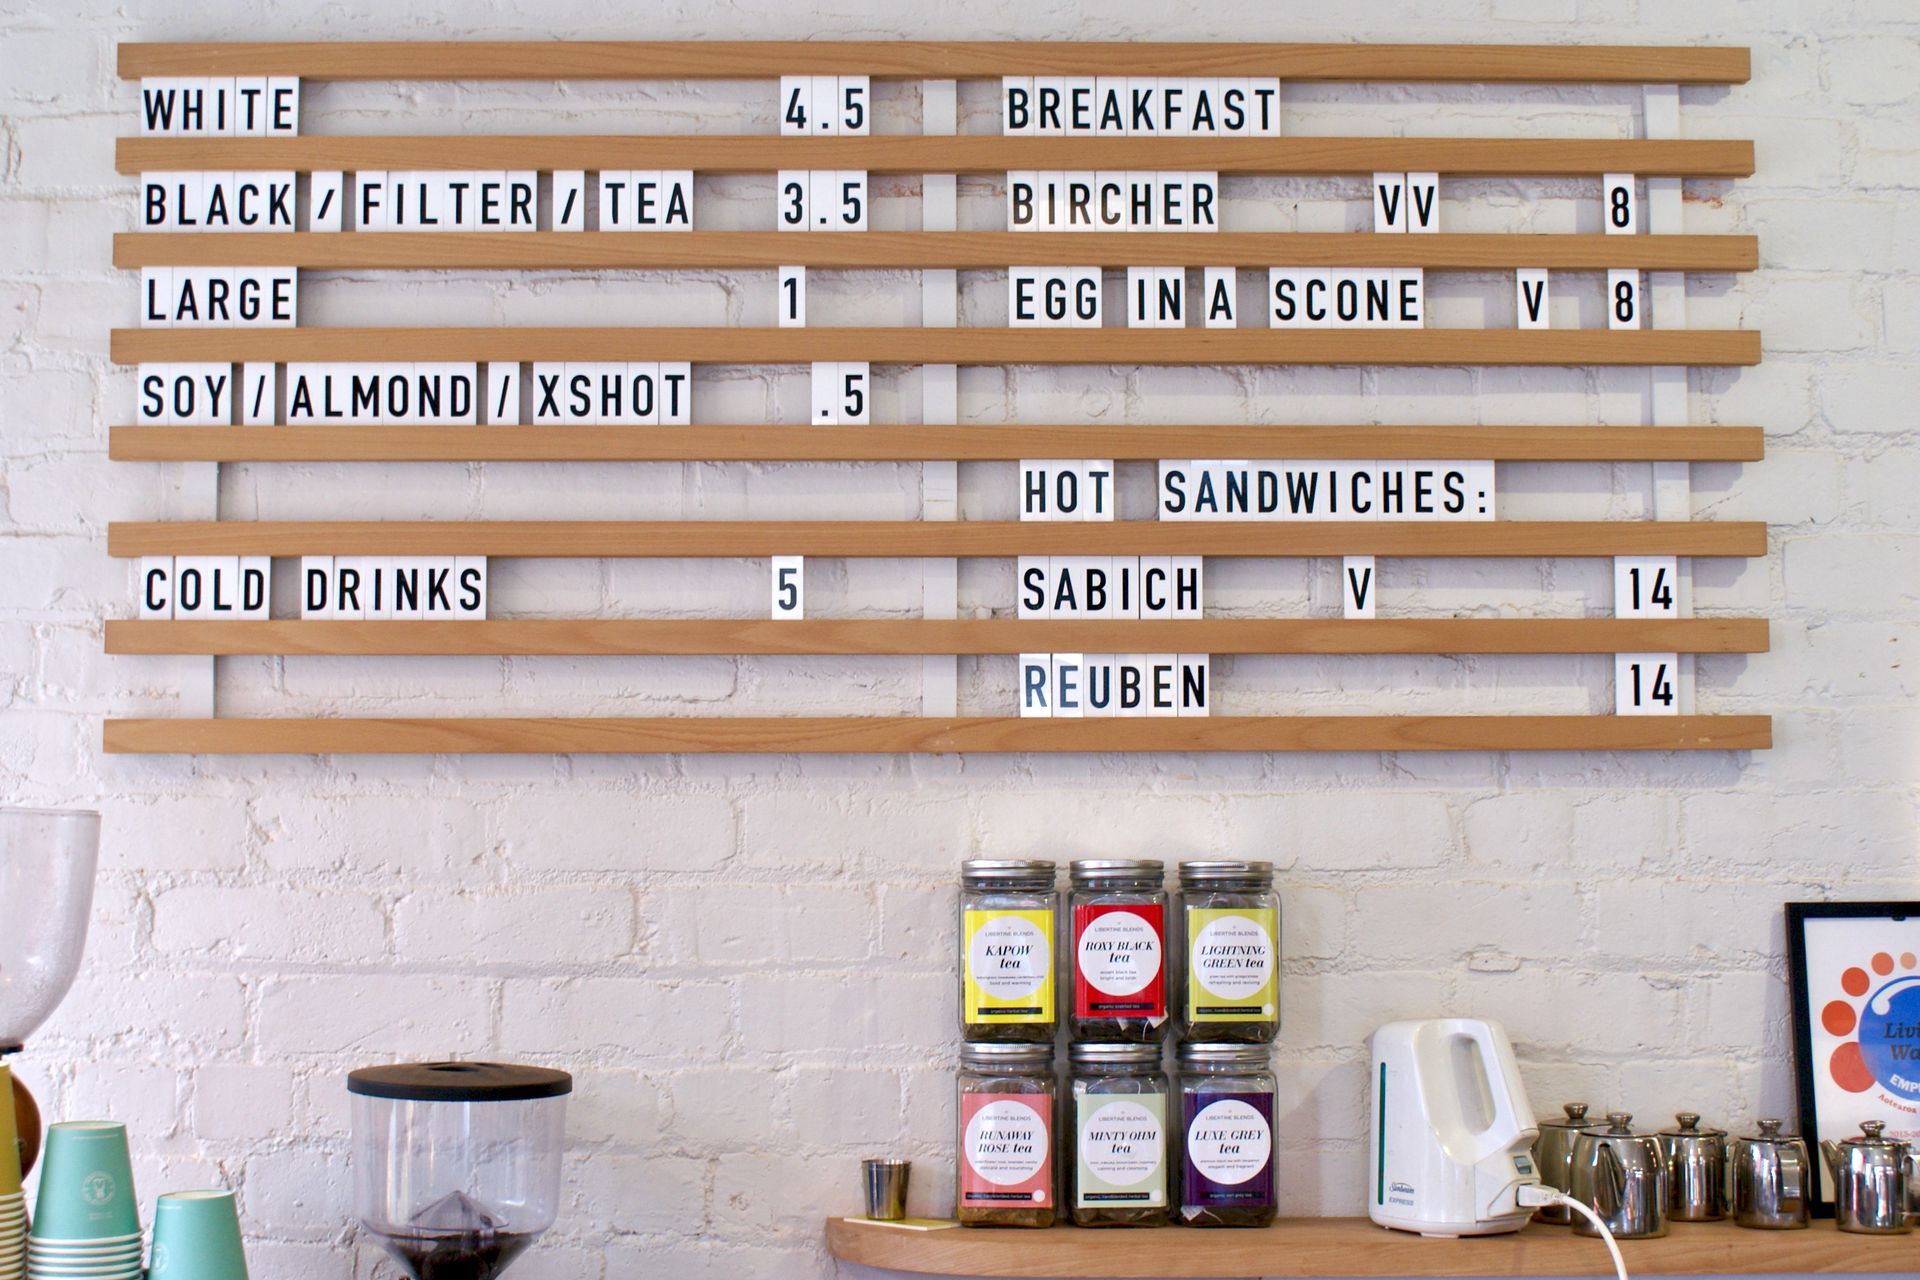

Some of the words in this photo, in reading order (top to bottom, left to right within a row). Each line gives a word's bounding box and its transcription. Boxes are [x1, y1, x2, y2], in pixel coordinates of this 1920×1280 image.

[144, 89, 293, 130] WHITE
[786, 88, 863, 129] 4.5
[1008, 88, 1275, 131] BREAKFAST
[146, 183, 291, 225] BLACK
[363, 183, 532, 225] FILTER
[605, 183, 689, 224] TEA
[784, 182, 861, 224] 3.5
[1013, 183, 1214, 225] BIRCHER
[1378, 184, 1435, 227] VV
[1611, 186, 1630, 228] 8
[148, 278, 292, 321] LARGE
[784, 277, 797, 319] 1
[1016, 278, 1097, 320] EGG
[1138, 279, 1181, 321] IN
[1209, 278, 1233, 321] A
[1275, 279, 1418, 322] SCONE
[1522, 280, 1544, 322] V
[1615, 280, 1633, 323] 8
[143, 375, 227, 418] SOY
[290, 375, 472, 418] ALMOND
[537, 374, 685, 417] XSHOT
[821, 374, 863, 417] .5
[1025, 470, 1109, 513] HOT
[1164, 470, 1487, 514] SANDWICHES:
[146, 568, 264, 611] COLD
[307, 568, 482, 611] DRINKS
[778, 568, 797, 611] 5
[1023, 567, 1198, 611] SABICH
[1348, 567, 1371, 610] V
[1629, 568, 1673, 610] 14
[1025, 665, 1205, 709] REUBEN
[1630, 664, 1673, 706] 14
[985, 945, 1033, 957] KAPOW
[1085, 941, 1115, 951] ROXY
[1117, 941, 1154, 951] BLACK
[1201, 945, 1266, 956] LIGHTNING
[1000, 958, 1021, 969] tea
[1109, 953, 1130, 963] tea
[1203, 958, 1244, 968] GREEN
[1245, 958, 1265, 968] tea
[1889, 1073, 1920, 1094] EMP
[1878, 1093, 1918, 1115] Aotearoa
[980, 1130, 1034, 1141] RUNAWAY
[1088, 1131, 1128, 1141] MINTY
[1129, 1131, 1156, 1141] OHM
[1195, 1130, 1227, 1141] LUXE
[1230, 1129, 1264, 1140] GREY
[978, 1143, 1009, 1153] ROSE
[1013, 1143, 1033, 1153] tea
[1111, 1143, 1131, 1154] tea
[1219, 1143, 1240, 1154] tea
